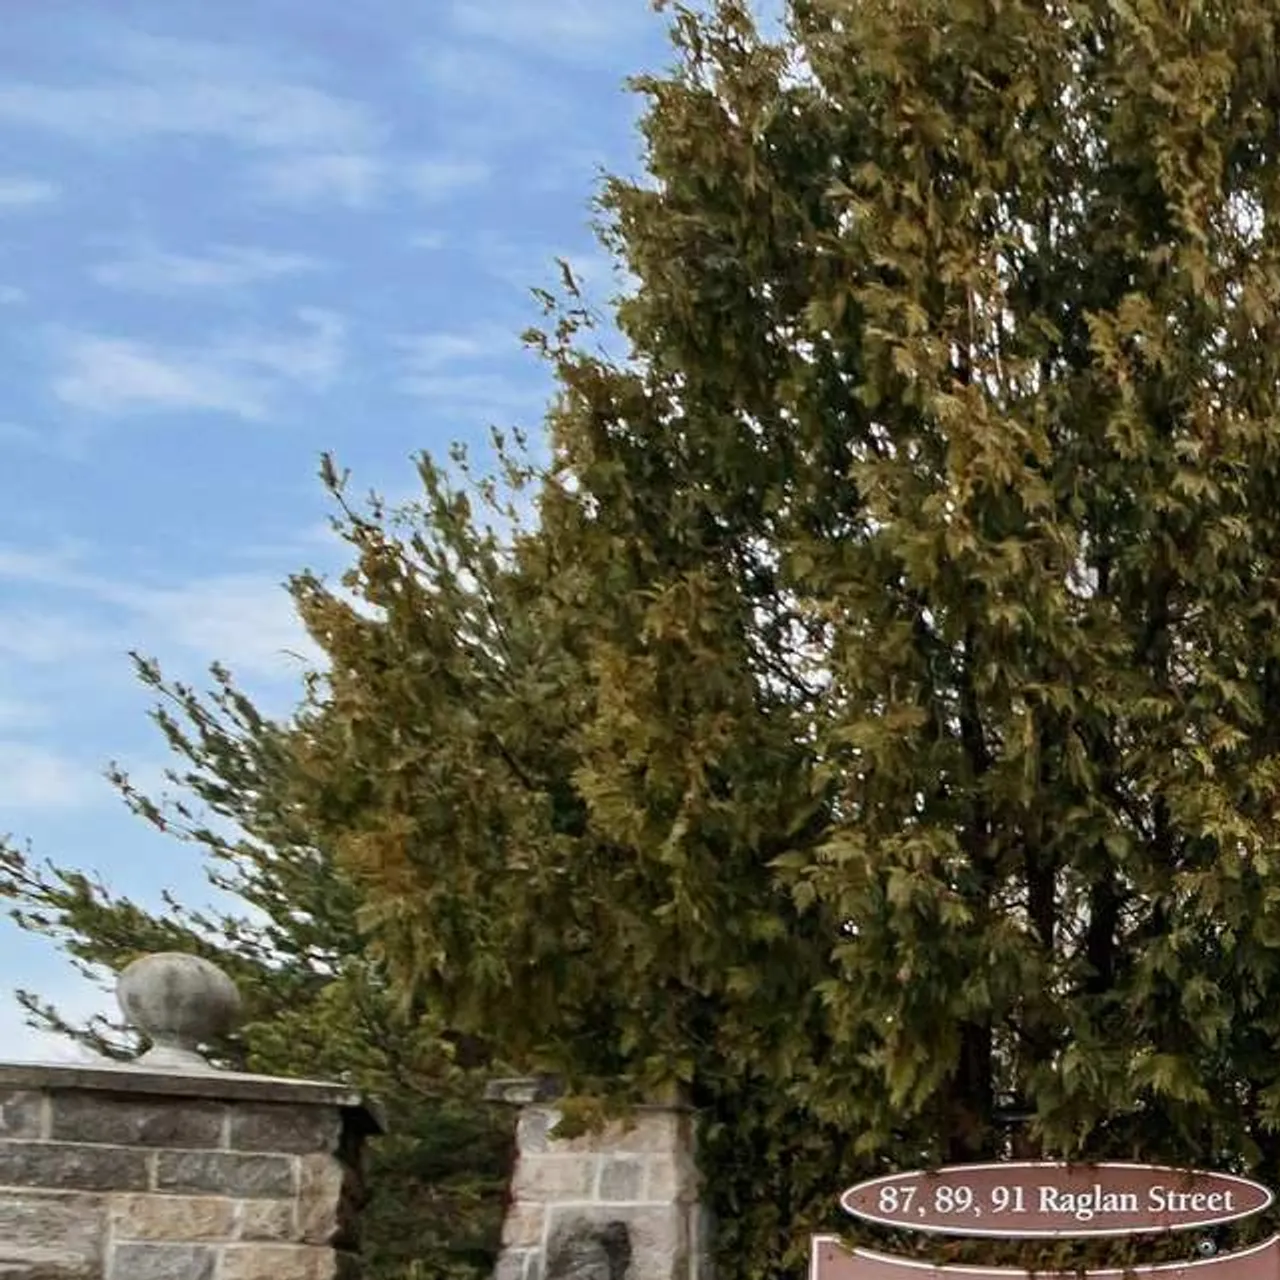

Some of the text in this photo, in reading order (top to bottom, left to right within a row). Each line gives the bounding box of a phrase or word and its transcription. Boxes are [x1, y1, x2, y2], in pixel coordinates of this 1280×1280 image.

[878, 1184, 1236, 1221] 87, 89, 91 Raglan Street
